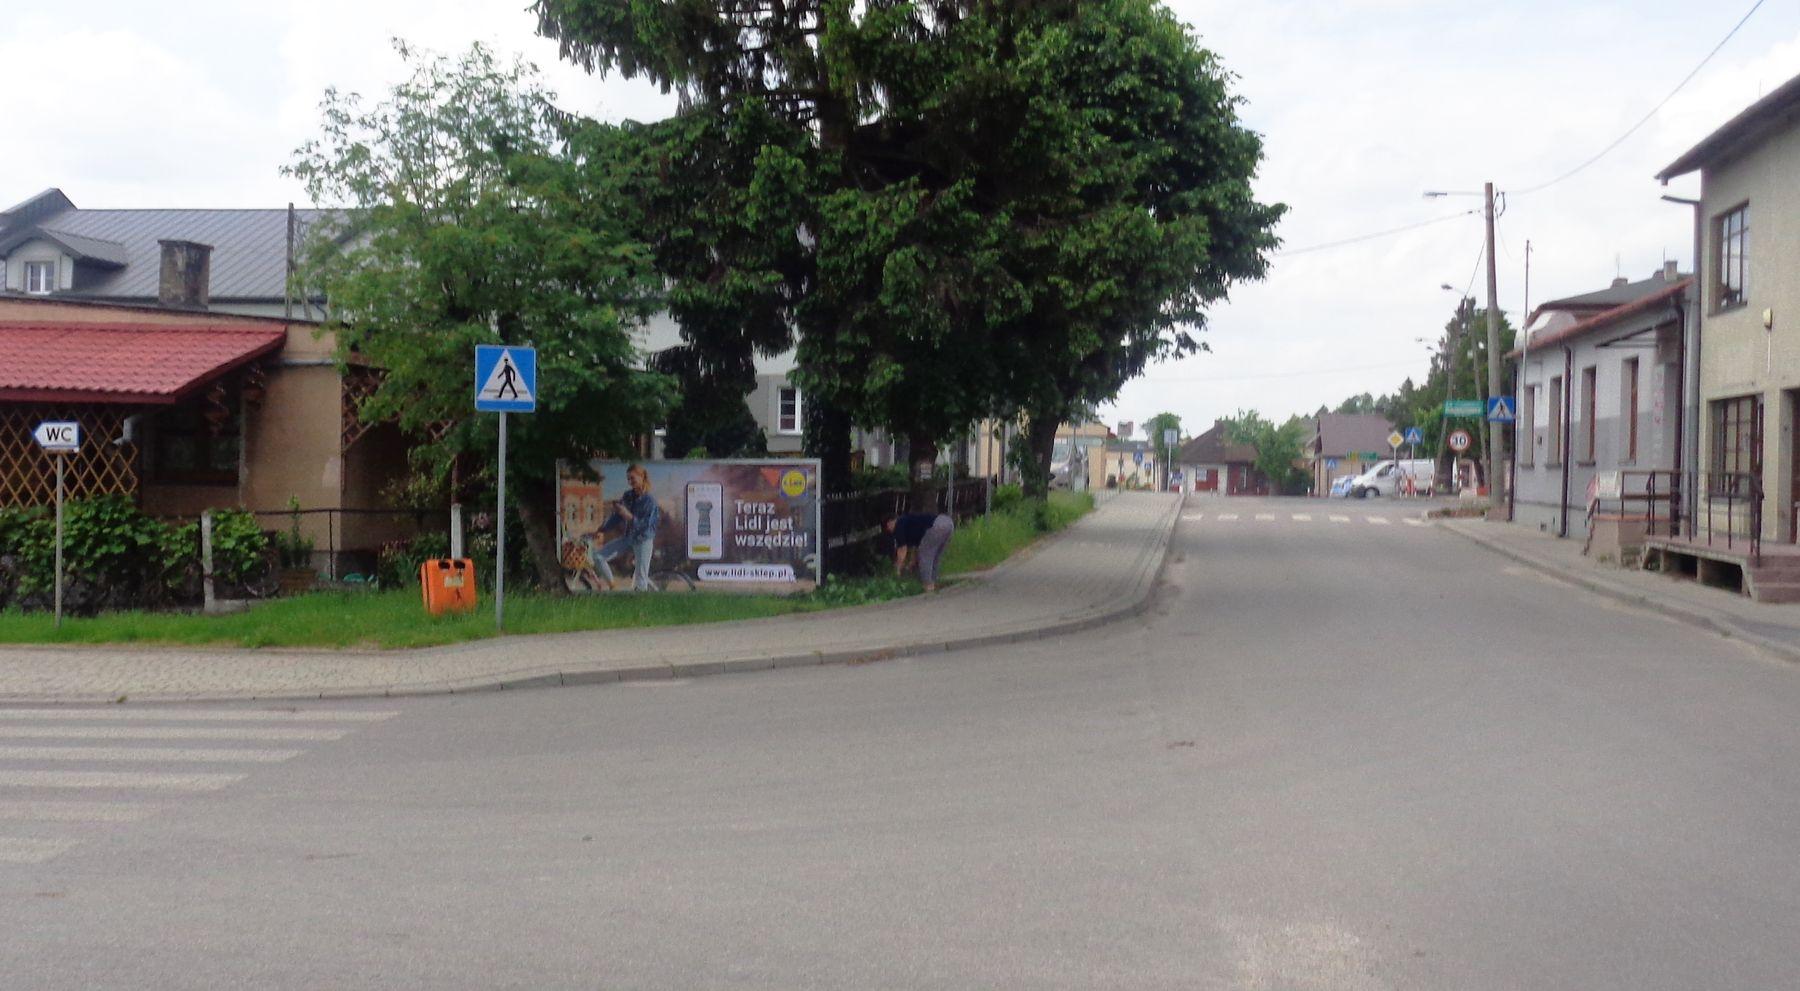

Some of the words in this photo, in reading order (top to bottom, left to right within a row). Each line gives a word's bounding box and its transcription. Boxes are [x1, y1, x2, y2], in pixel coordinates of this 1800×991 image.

[46, 427, 72, 441] WC
[735, 499, 775, 514] Teraz
[735, 515, 762, 530] Lidl
[765, 515, 793, 534] jest
